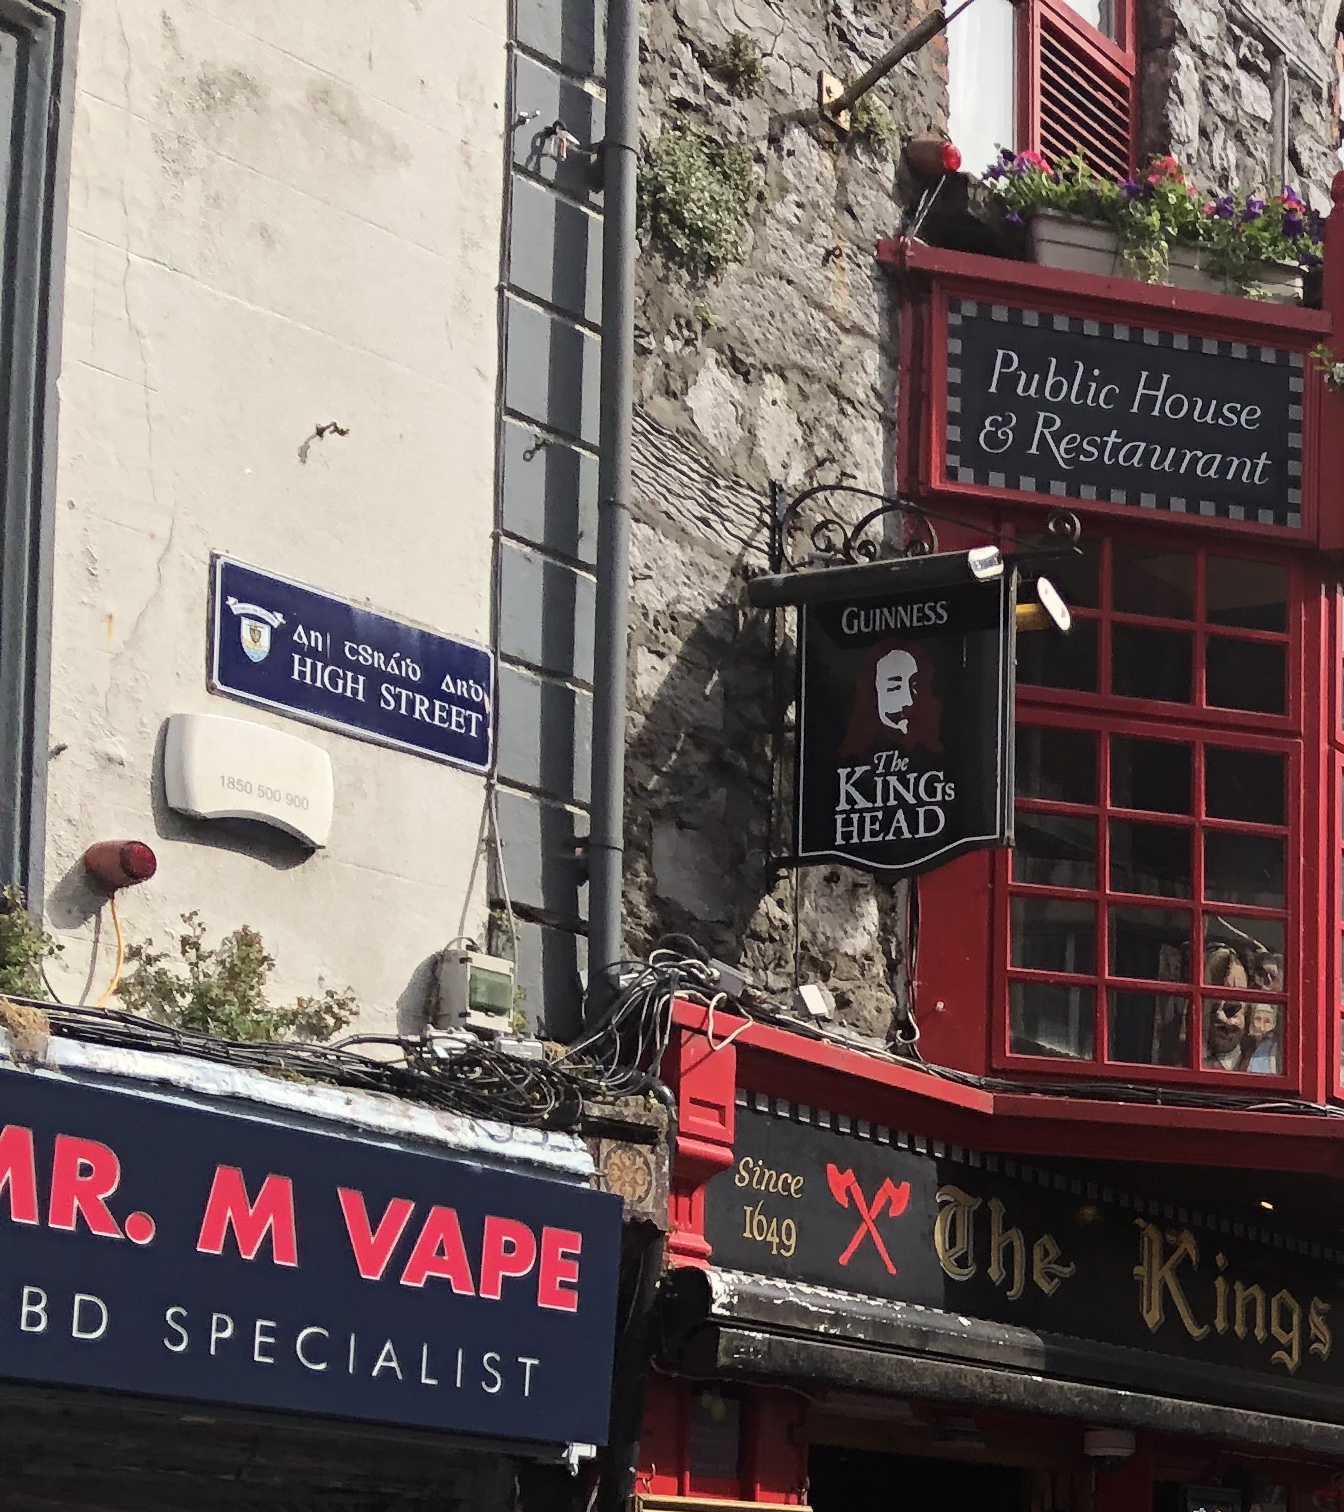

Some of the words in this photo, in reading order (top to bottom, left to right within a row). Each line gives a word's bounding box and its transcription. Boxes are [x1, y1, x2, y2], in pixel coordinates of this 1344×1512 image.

[987, 348, 1120, 411] Public
[1130, 370, 1262, 431] House
[977, 412, 1016, 453] &
[1027, 411, 1272, 486] Restaurant
[841, 600, 949, 635] GUINNESS
[291, 653, 367, 703] HIGH
[380, 683, 483, 738] STREET
[220, 775, 253, 795] 1850
[257, 784, 282, 803] 500
[285, 792, 309, 811] 900
[873, 750, 909, 774] The
[834, 804, 946, 846] HEAD
[734, 1156, 804, 1199] Since
[195, 1163, 299, 1269] M
[337, 1186, 584, 1314] VAPE
[742, 1200, 797, 1258] 1649
[933, 1184, 1077, 1301] The
[1132, 1217, 1334, 1375] Kings
[163, 1305, 542, 1398] SPECIALIST
